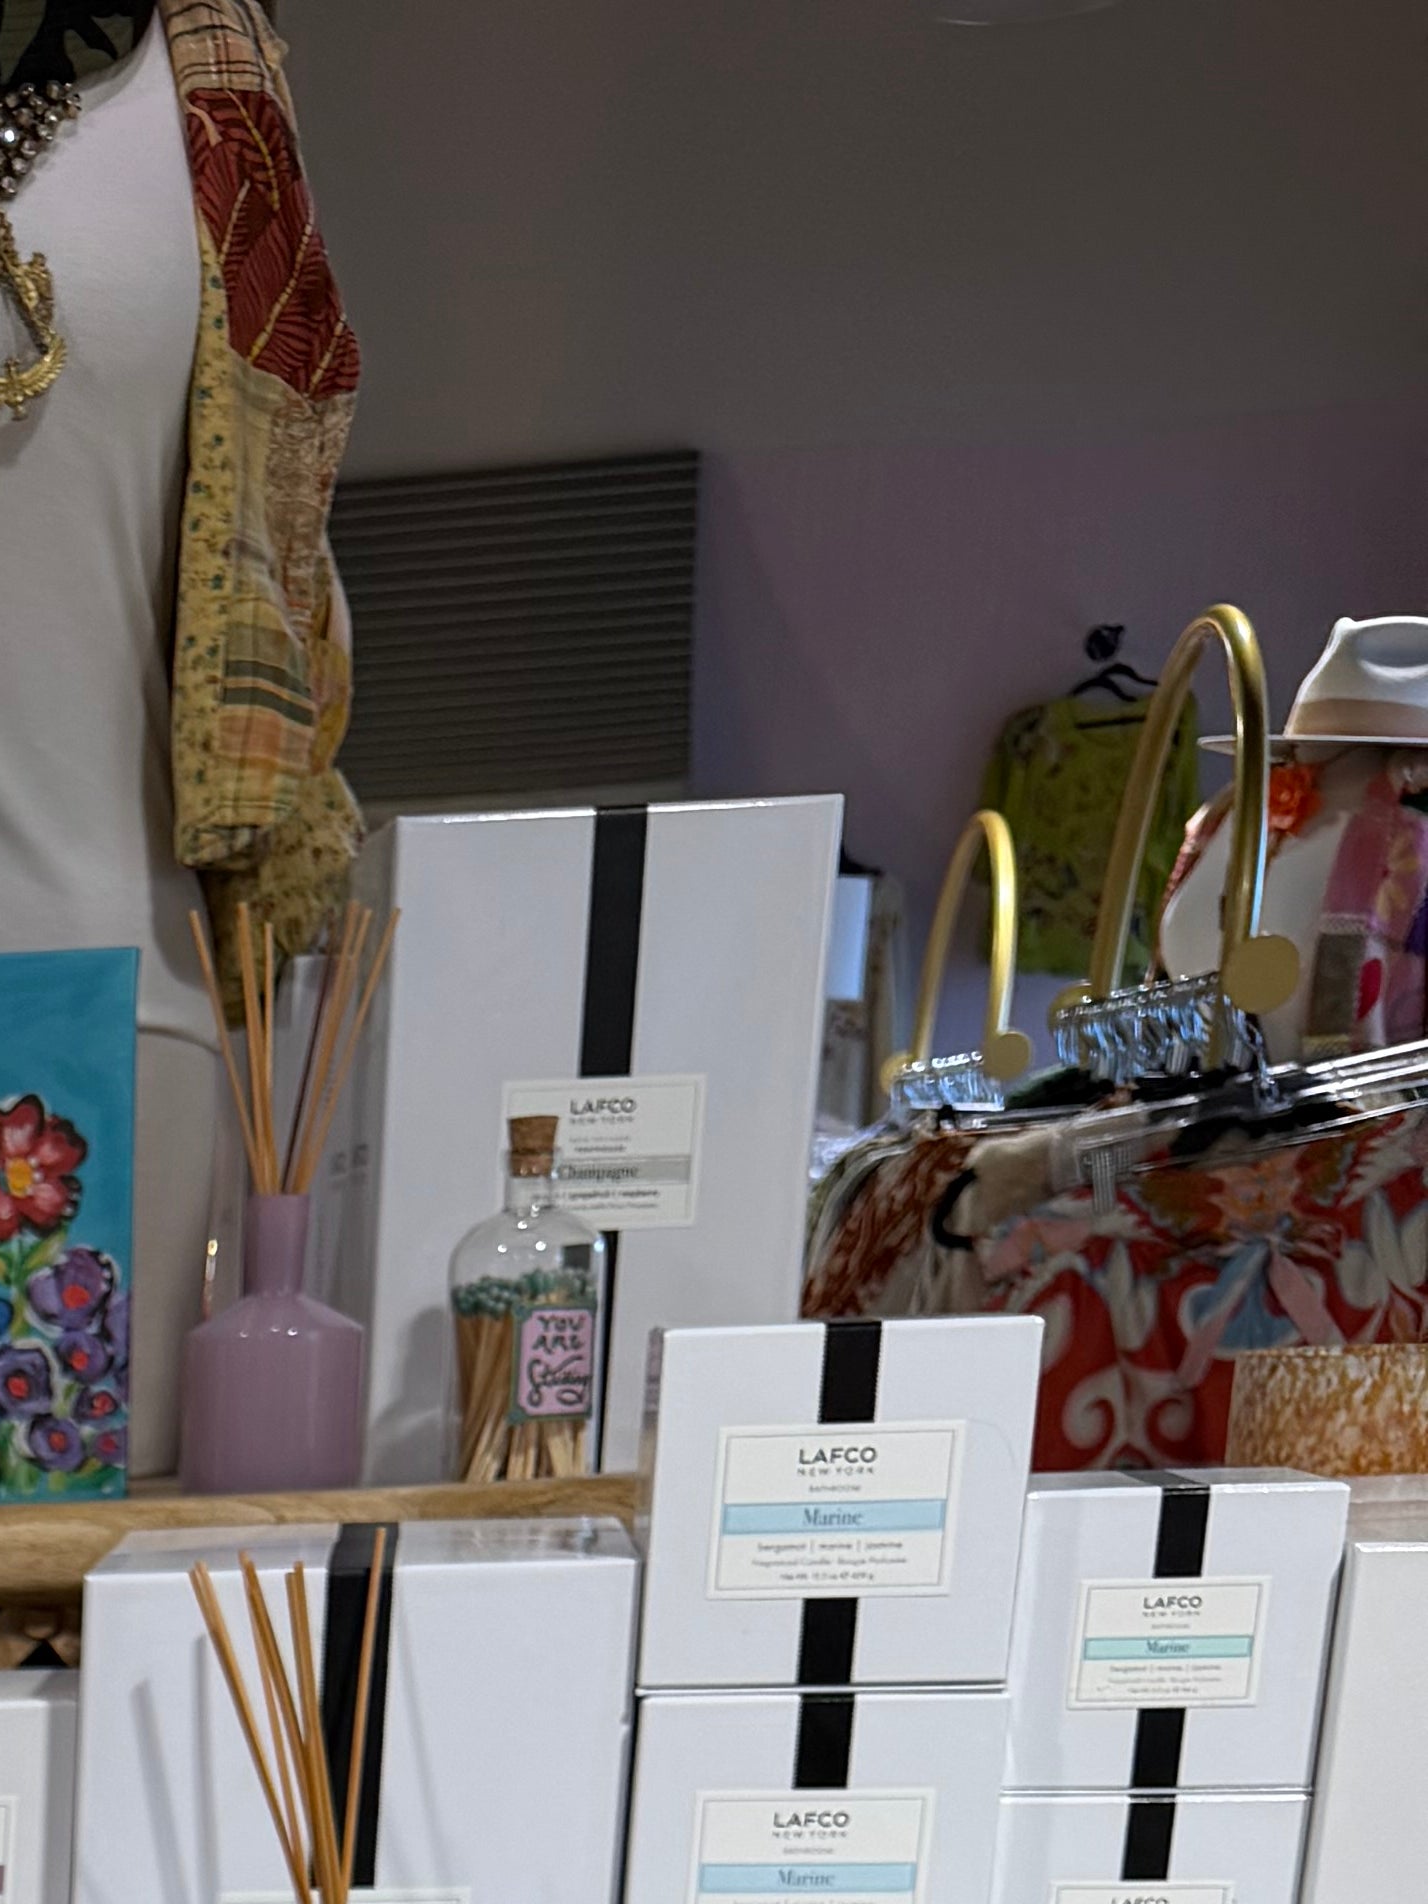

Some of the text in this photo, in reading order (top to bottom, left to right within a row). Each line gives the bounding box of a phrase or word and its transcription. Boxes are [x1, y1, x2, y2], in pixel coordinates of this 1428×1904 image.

[570, 1098, 637, 1115] LAFCO
[537, 1315, 586, 1331] YOU
[532, 1335, 584, 1354] ARE
[798, 1447, 878, 1464] LAFCO
[797, 1466, 874, 1477] NEW YORK
[803, 1508, 863, 1527] Marine
[1143, 1596, 1202, 1609] LAFCO
[1146, 1639, 1190, 1655] Marine
[773, 1811, 851, 1828] LAFCO
[772, 1830, 847, 1839] NEW YORK
[778, 1869, 835, 1886] Marine
